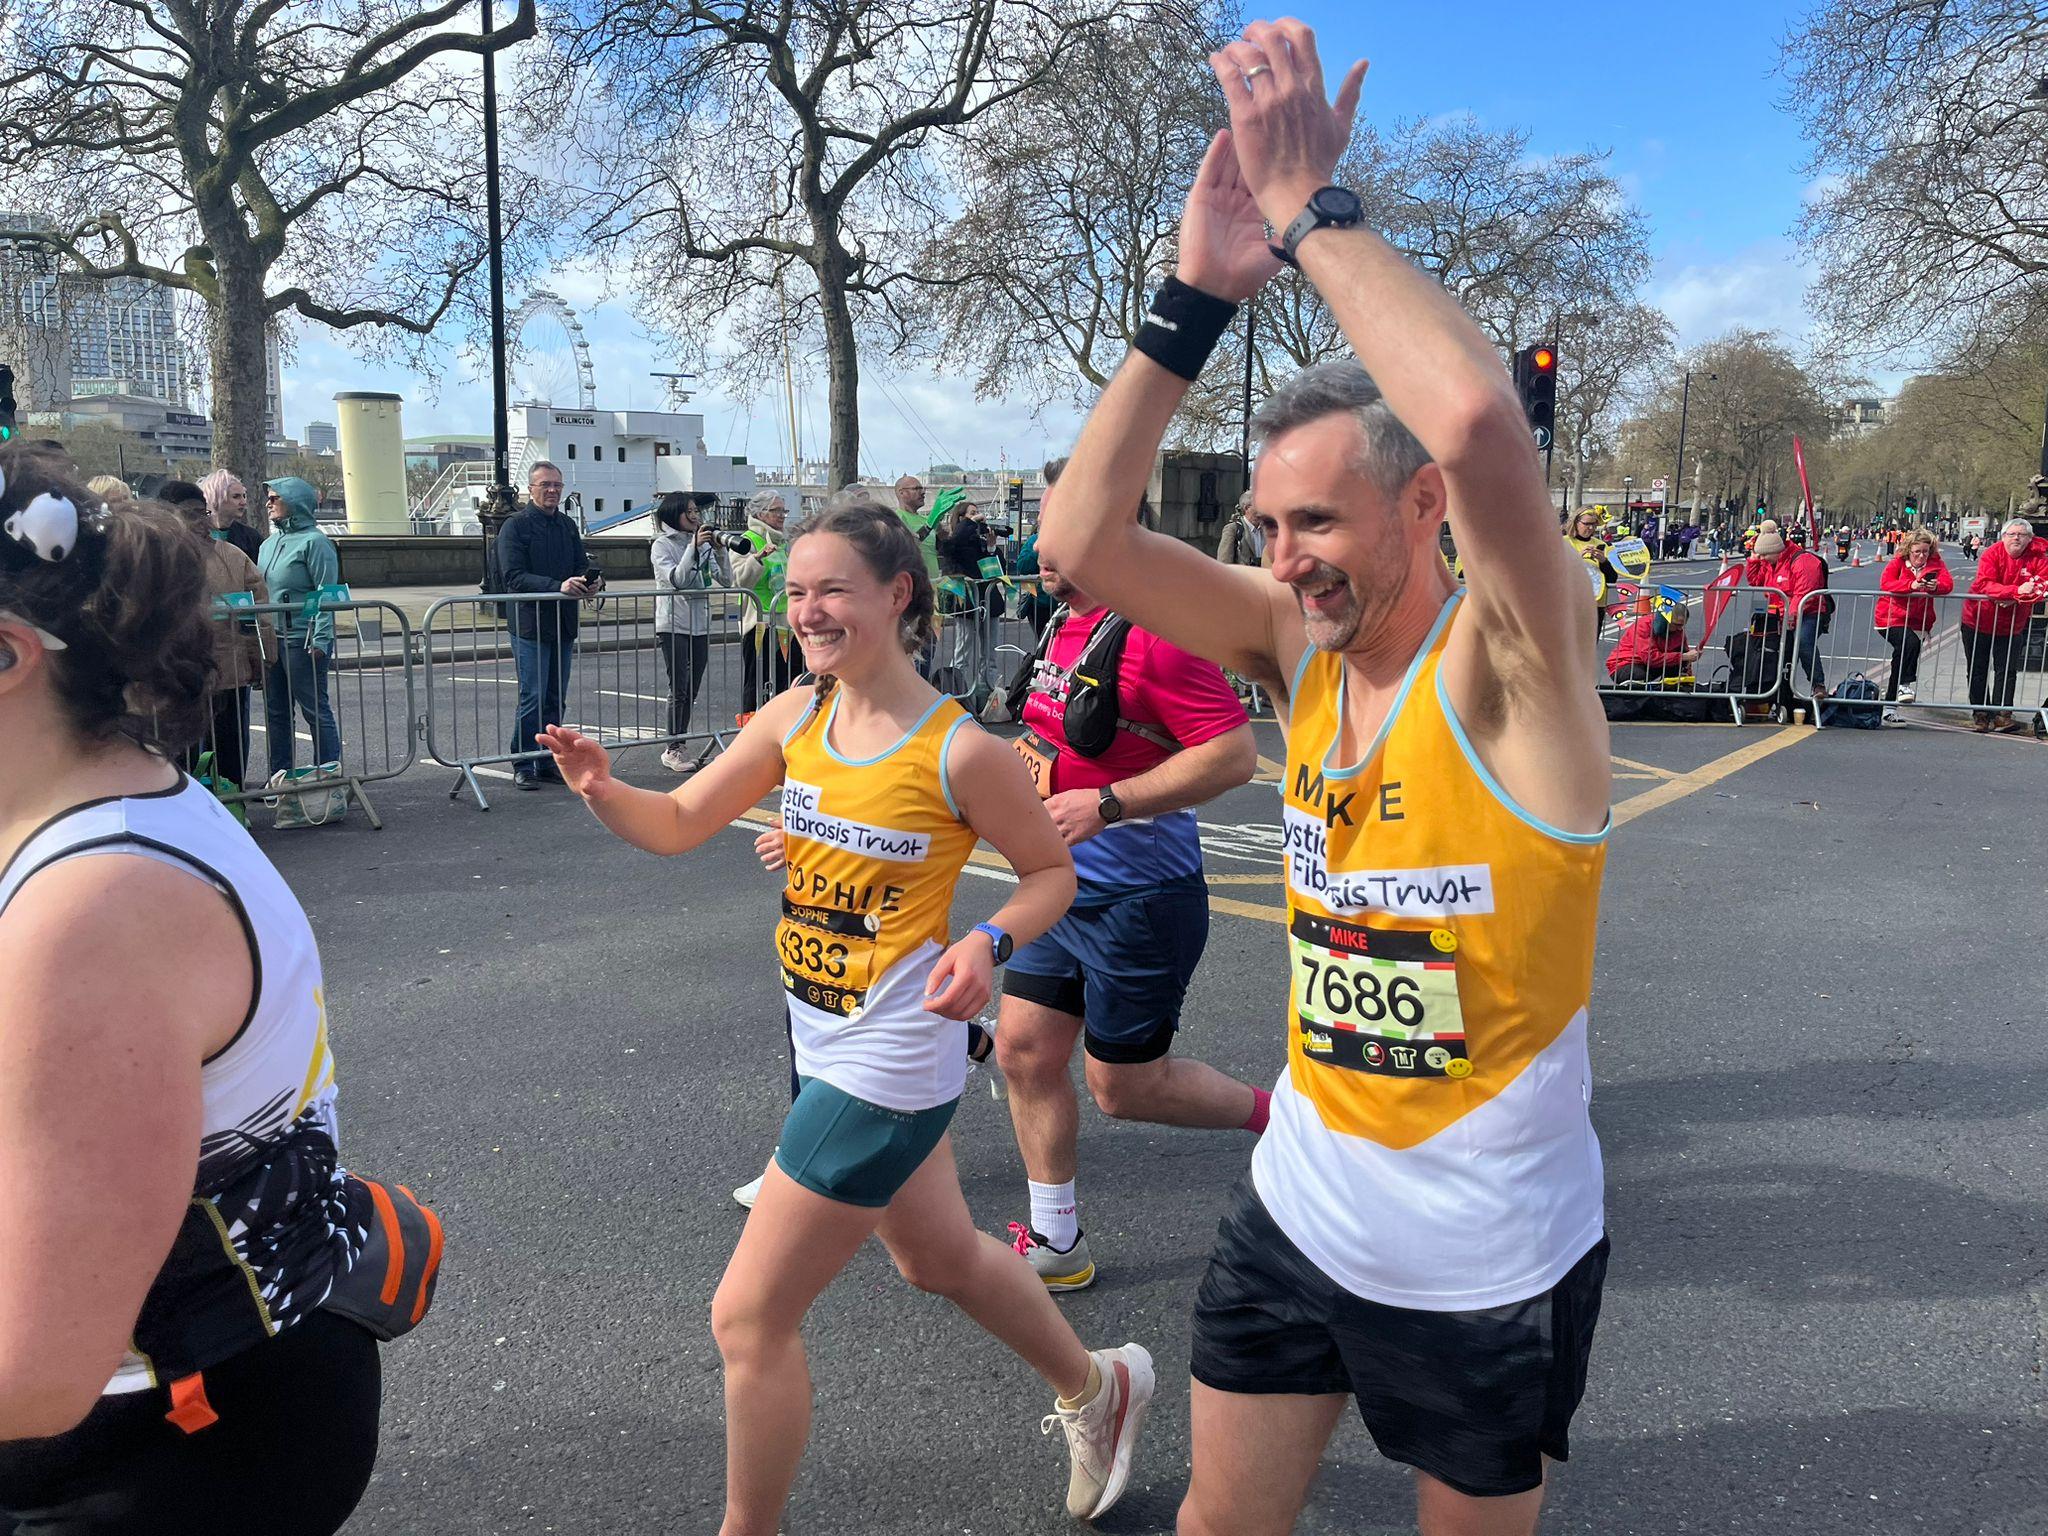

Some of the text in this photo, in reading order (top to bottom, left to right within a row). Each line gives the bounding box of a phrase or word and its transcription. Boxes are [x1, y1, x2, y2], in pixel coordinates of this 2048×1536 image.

[555, 416, 595, 425] WELLINGTON
[1294, 763, 1405, 829] MKE
[785, 807, 922, 857] Fibrosis Trust
[1283, 818, 1327, 859] ystic
[1368, 875, 1481, 907] Trust
[791, 905, 829, 925] SOPHIE
[780, 926, 848, 978] 4333
[1329, 926, 1369, 950] MIKE
[1302, 956, 1425, 1027] 7686
[1399, 1052, 1409, 1065] M
[1434, 1057, 1442, 1065] 3
